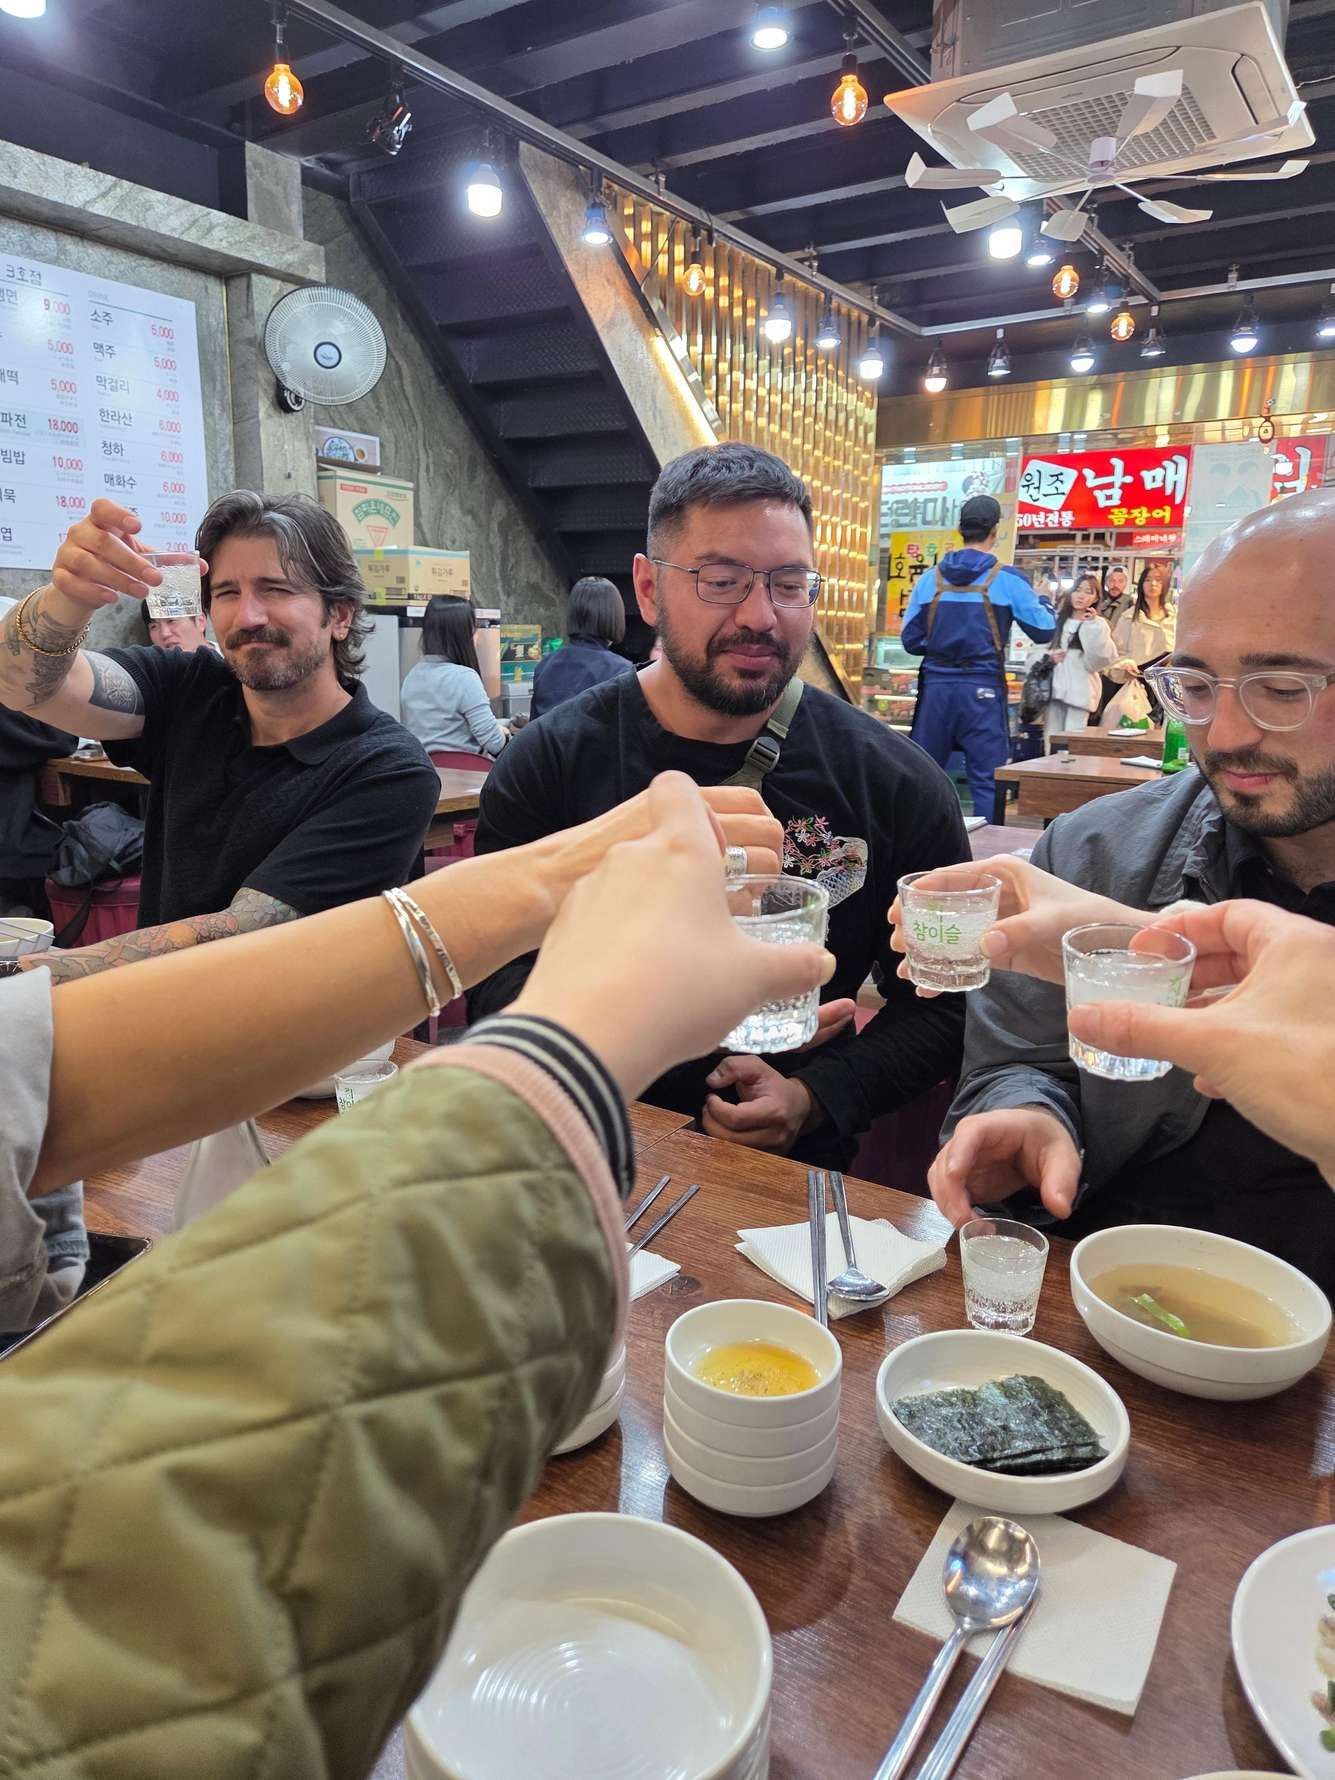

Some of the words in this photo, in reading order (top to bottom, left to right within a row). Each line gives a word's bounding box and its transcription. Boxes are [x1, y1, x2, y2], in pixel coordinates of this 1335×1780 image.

[90, 309, 114, 326] 소주
[151, 324, 174, 340] 5,000
[48, 339, 73, 354] 5,000
[92, 341, 116, 359] 맥주
[153, 356, 177, 371] 5,000
[50, 378, 77, 394] 5,000
[96, 375, 130, 395] 막걸리
[156, 388, 179, 402] 4,000
[0, 411, 27, 429] 파전
[99, 407, 133, 427] 한라산
[48, 418, 79, 434] 18,000
[101, 440, 124, 456] 청하
[52, 456, 83, 471] 10,000
[103, 473, 137, 489] 매화수
[162, 480, 185, 494] 6,000
[1021, 468, 1066, 503] 원조
[1081, 454, 1189, 508] 남매
[0, 488, 16, 503] 묵
[56, 495, 86, 510] 18,000
[160, 511, 187, 524] 10,000
[1016, 510, 1075, 528] 50년전통
[1107, 505, 1171, 527] 꼼장어
[913, 920, 961, 944] 참이슬
